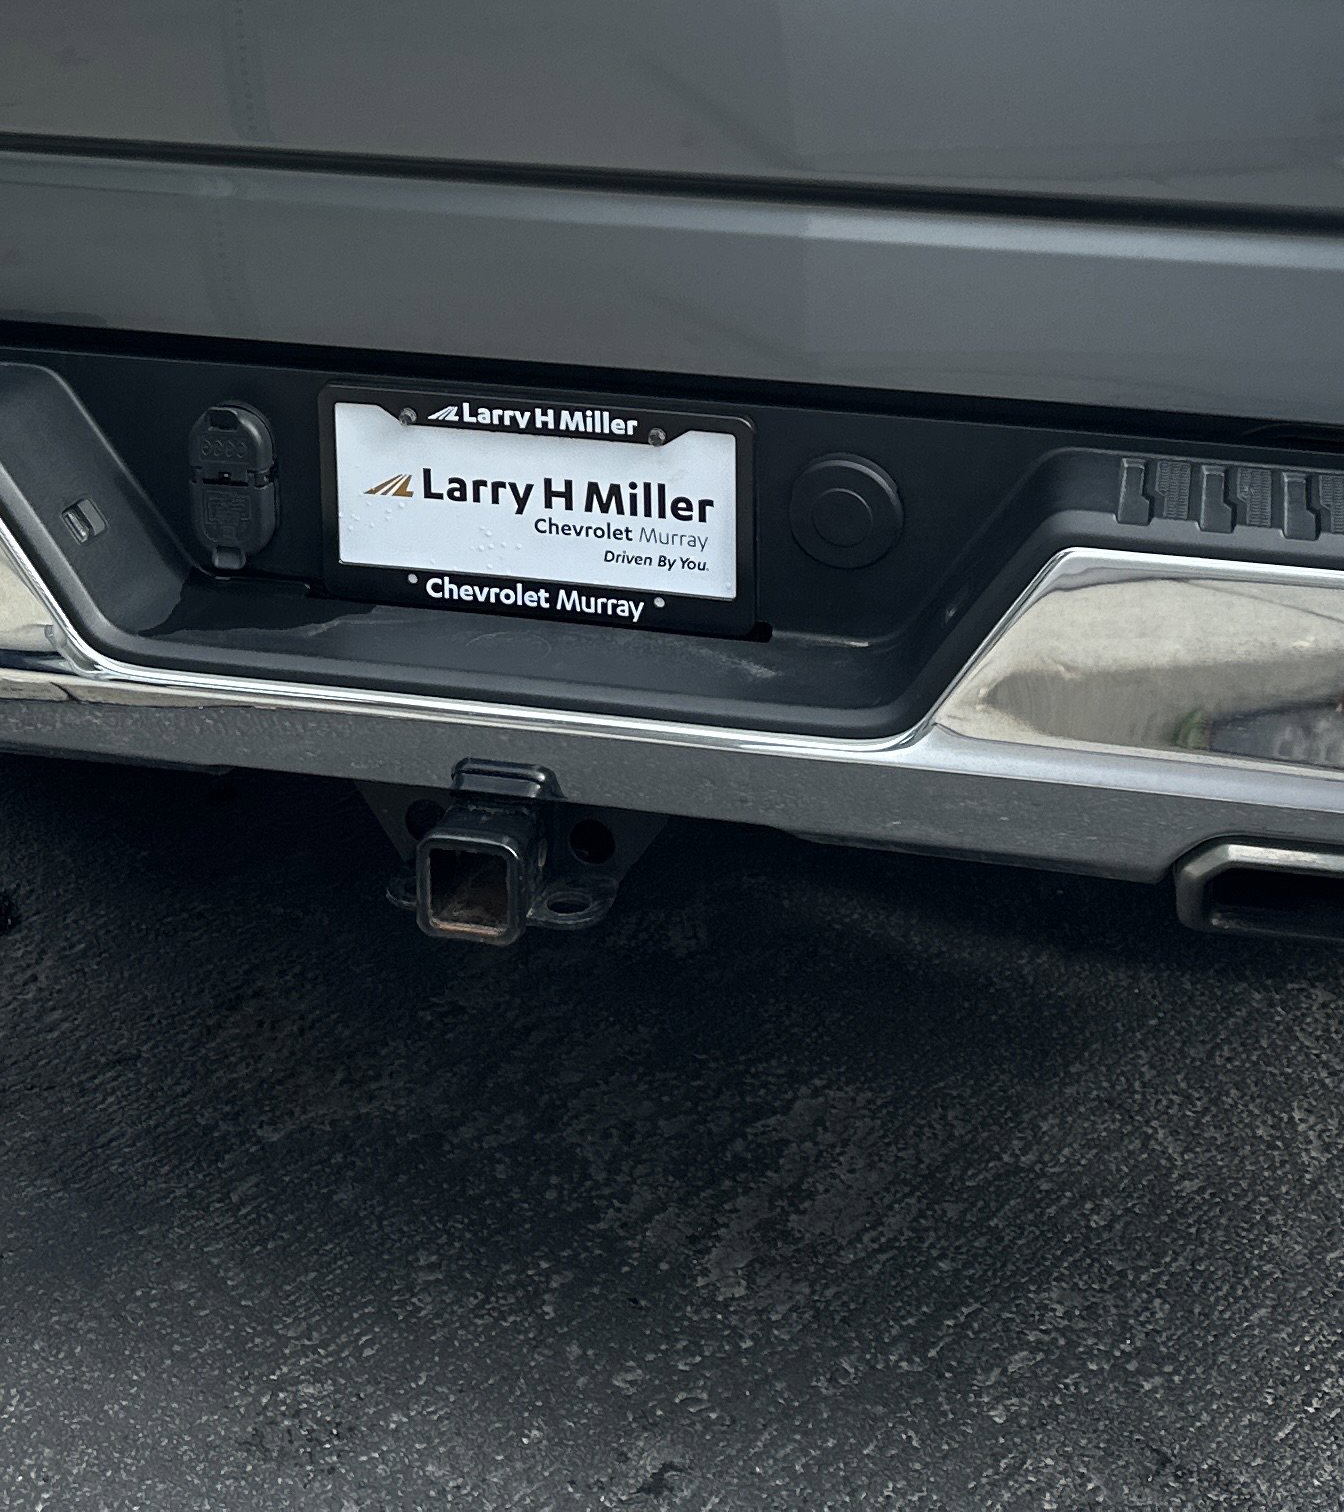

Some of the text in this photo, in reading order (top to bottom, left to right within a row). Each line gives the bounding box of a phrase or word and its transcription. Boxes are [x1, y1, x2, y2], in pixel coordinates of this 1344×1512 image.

[462, 402, 639, 436] Larry H Miller
[422, 467, 715, 525] Larry H Miller
[534, 517, 709, 552] Chevrolet Murray
[603, 549, 653, 567] Driven
[657, 554, 677, 572] By
[425, 576, 646, 624] Chevrolet Murray
